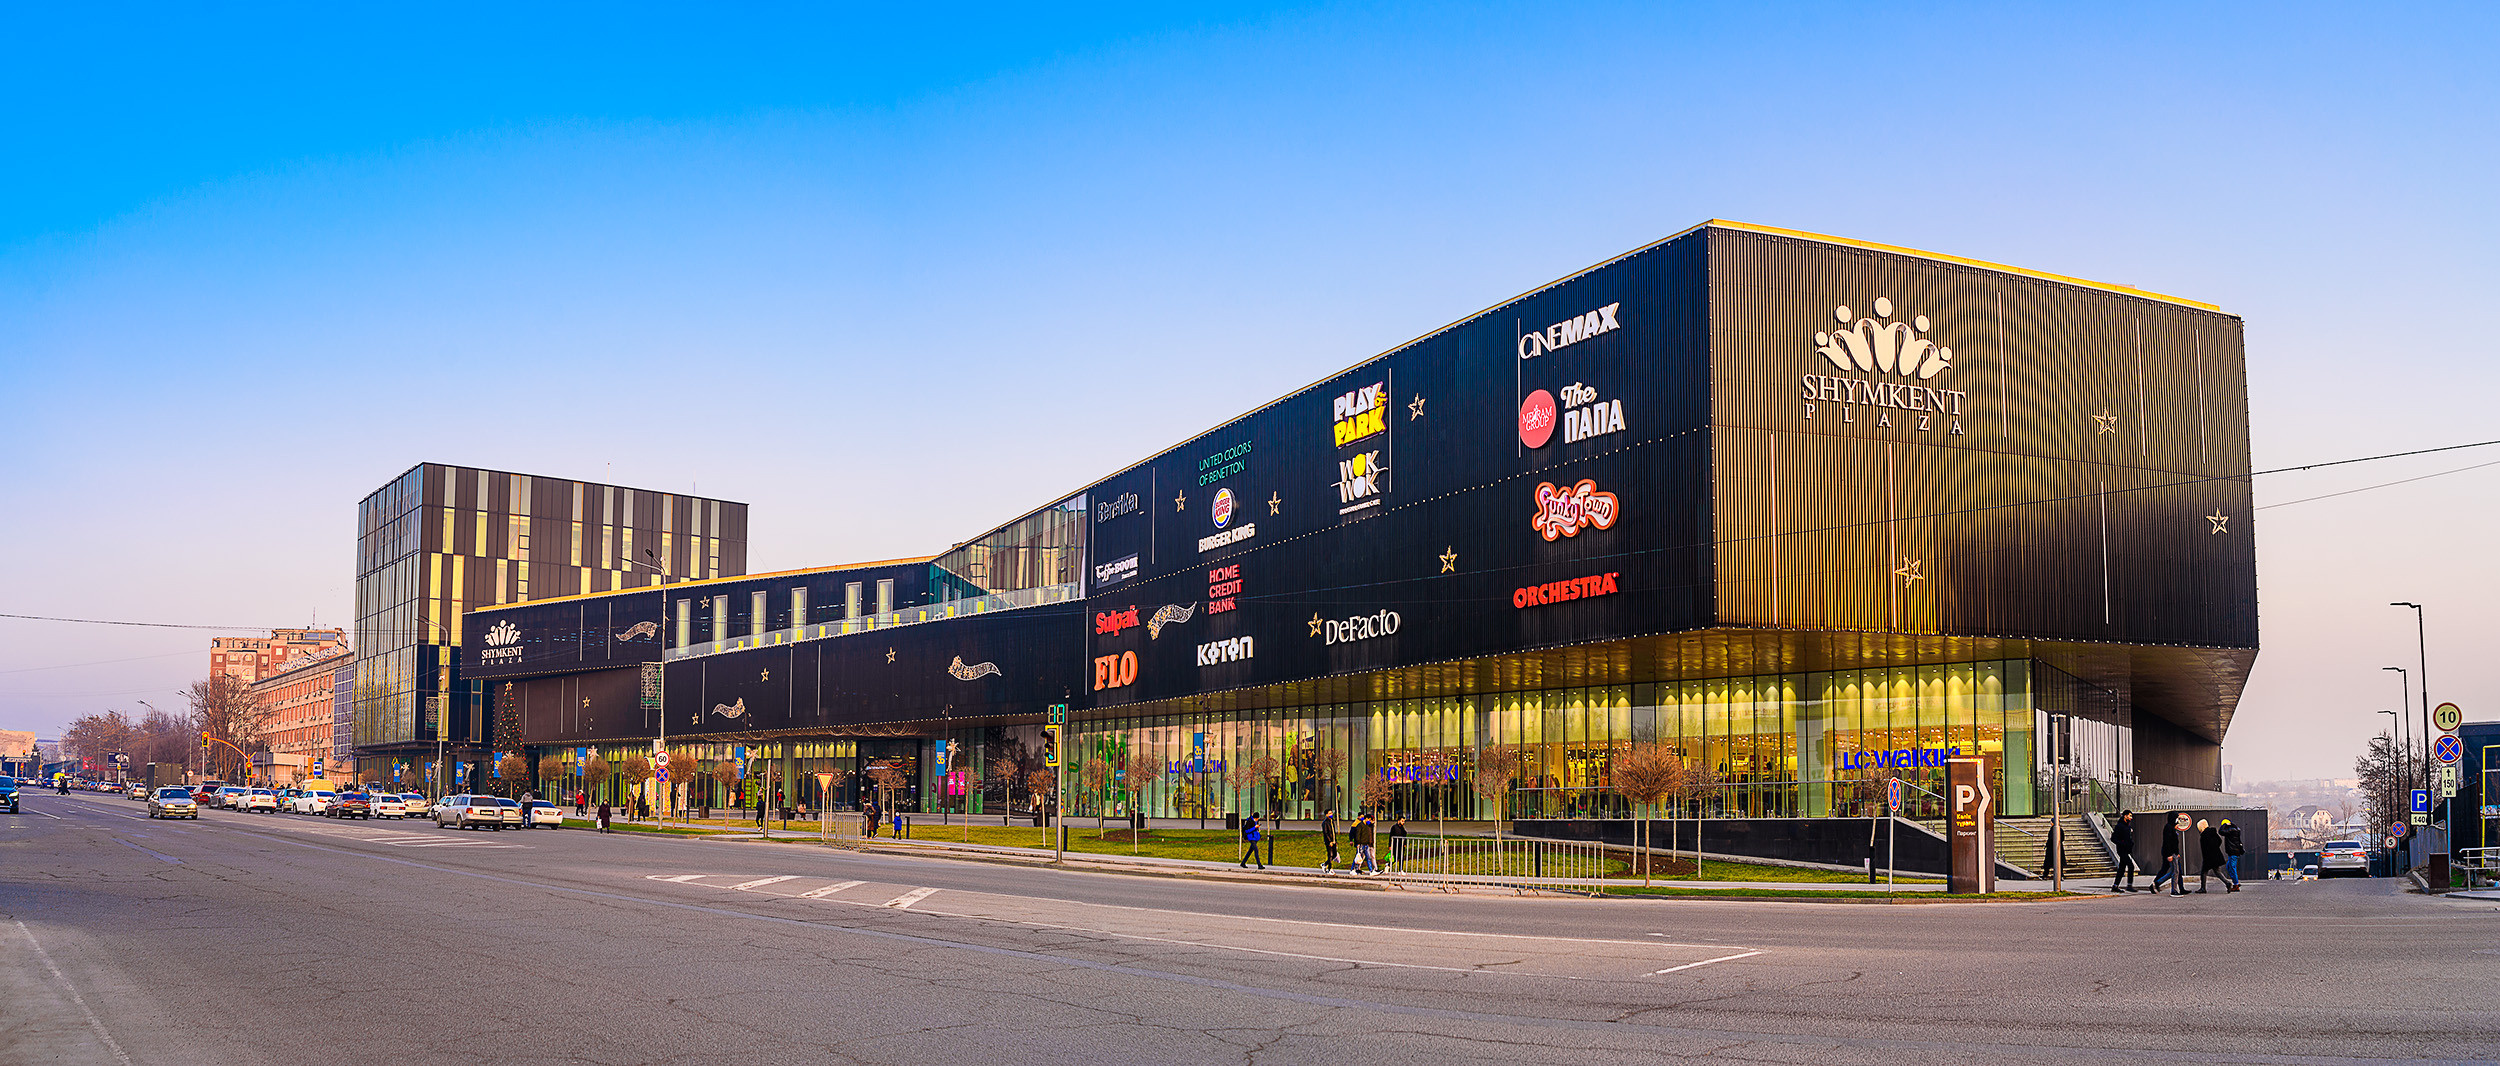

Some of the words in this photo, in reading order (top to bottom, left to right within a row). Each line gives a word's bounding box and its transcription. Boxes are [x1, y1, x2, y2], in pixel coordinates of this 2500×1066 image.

[1519, 302, 1620, 359] CINEMAX
[1334, 381, 1383, 422] PLAY
[1560, 381, 1597, 410] The
[1803, 374, 1966, 415] SHYMKENT
[1333, 406, 1386, 448] PARK
[1526, 415, 1550, 431] GROUP
[1564, 398, 1626, 444] ПАПА
[1805, 403, 1964, 435] PLAZA
[1199, 452, 1223, 471] UNITED
[1224, 440, 1252, 462] COLORS
[1339, 450, 1380, 481] WOK
[1199, 473, 1209, 487] OF
[1208, 459, 1245, 483] BENETTON
[1339, 472, 1380, 503] WOK
[1214, 504, 1230, 519] KING
[1215, 497, 1230, 509] BURGER
[1198, 530, 1232, 553] BURGER
[1231, 522, 1256, 544] KING
[1209, 564, 1240, 584] HOME
[1209, 579, 1243, 599] CREDIT
[1513, 572, 1618, 609] ORCHESTRA
[1208, 596, 1237, 615] BANK
[1096, 604, 1141, 637] Sulpak
[1325, 608, 1401, 646] DeFacto
[481, 646, 524, 660] SHYMKENT
[481, 656, 523, 666] PLAZA
[1093, 650, 1138, 691] FLO
[2439, 711, 2456, 724] 10
[658, 755, 667, 763] 60
[1843, 751, 1871, 770] LC
[2443, 779, 2454, 788] 150
[1956, 785, 1975, 812] P
[2416, 793, 2427, 809] P
[2388, 838, 2394, 846] 5
